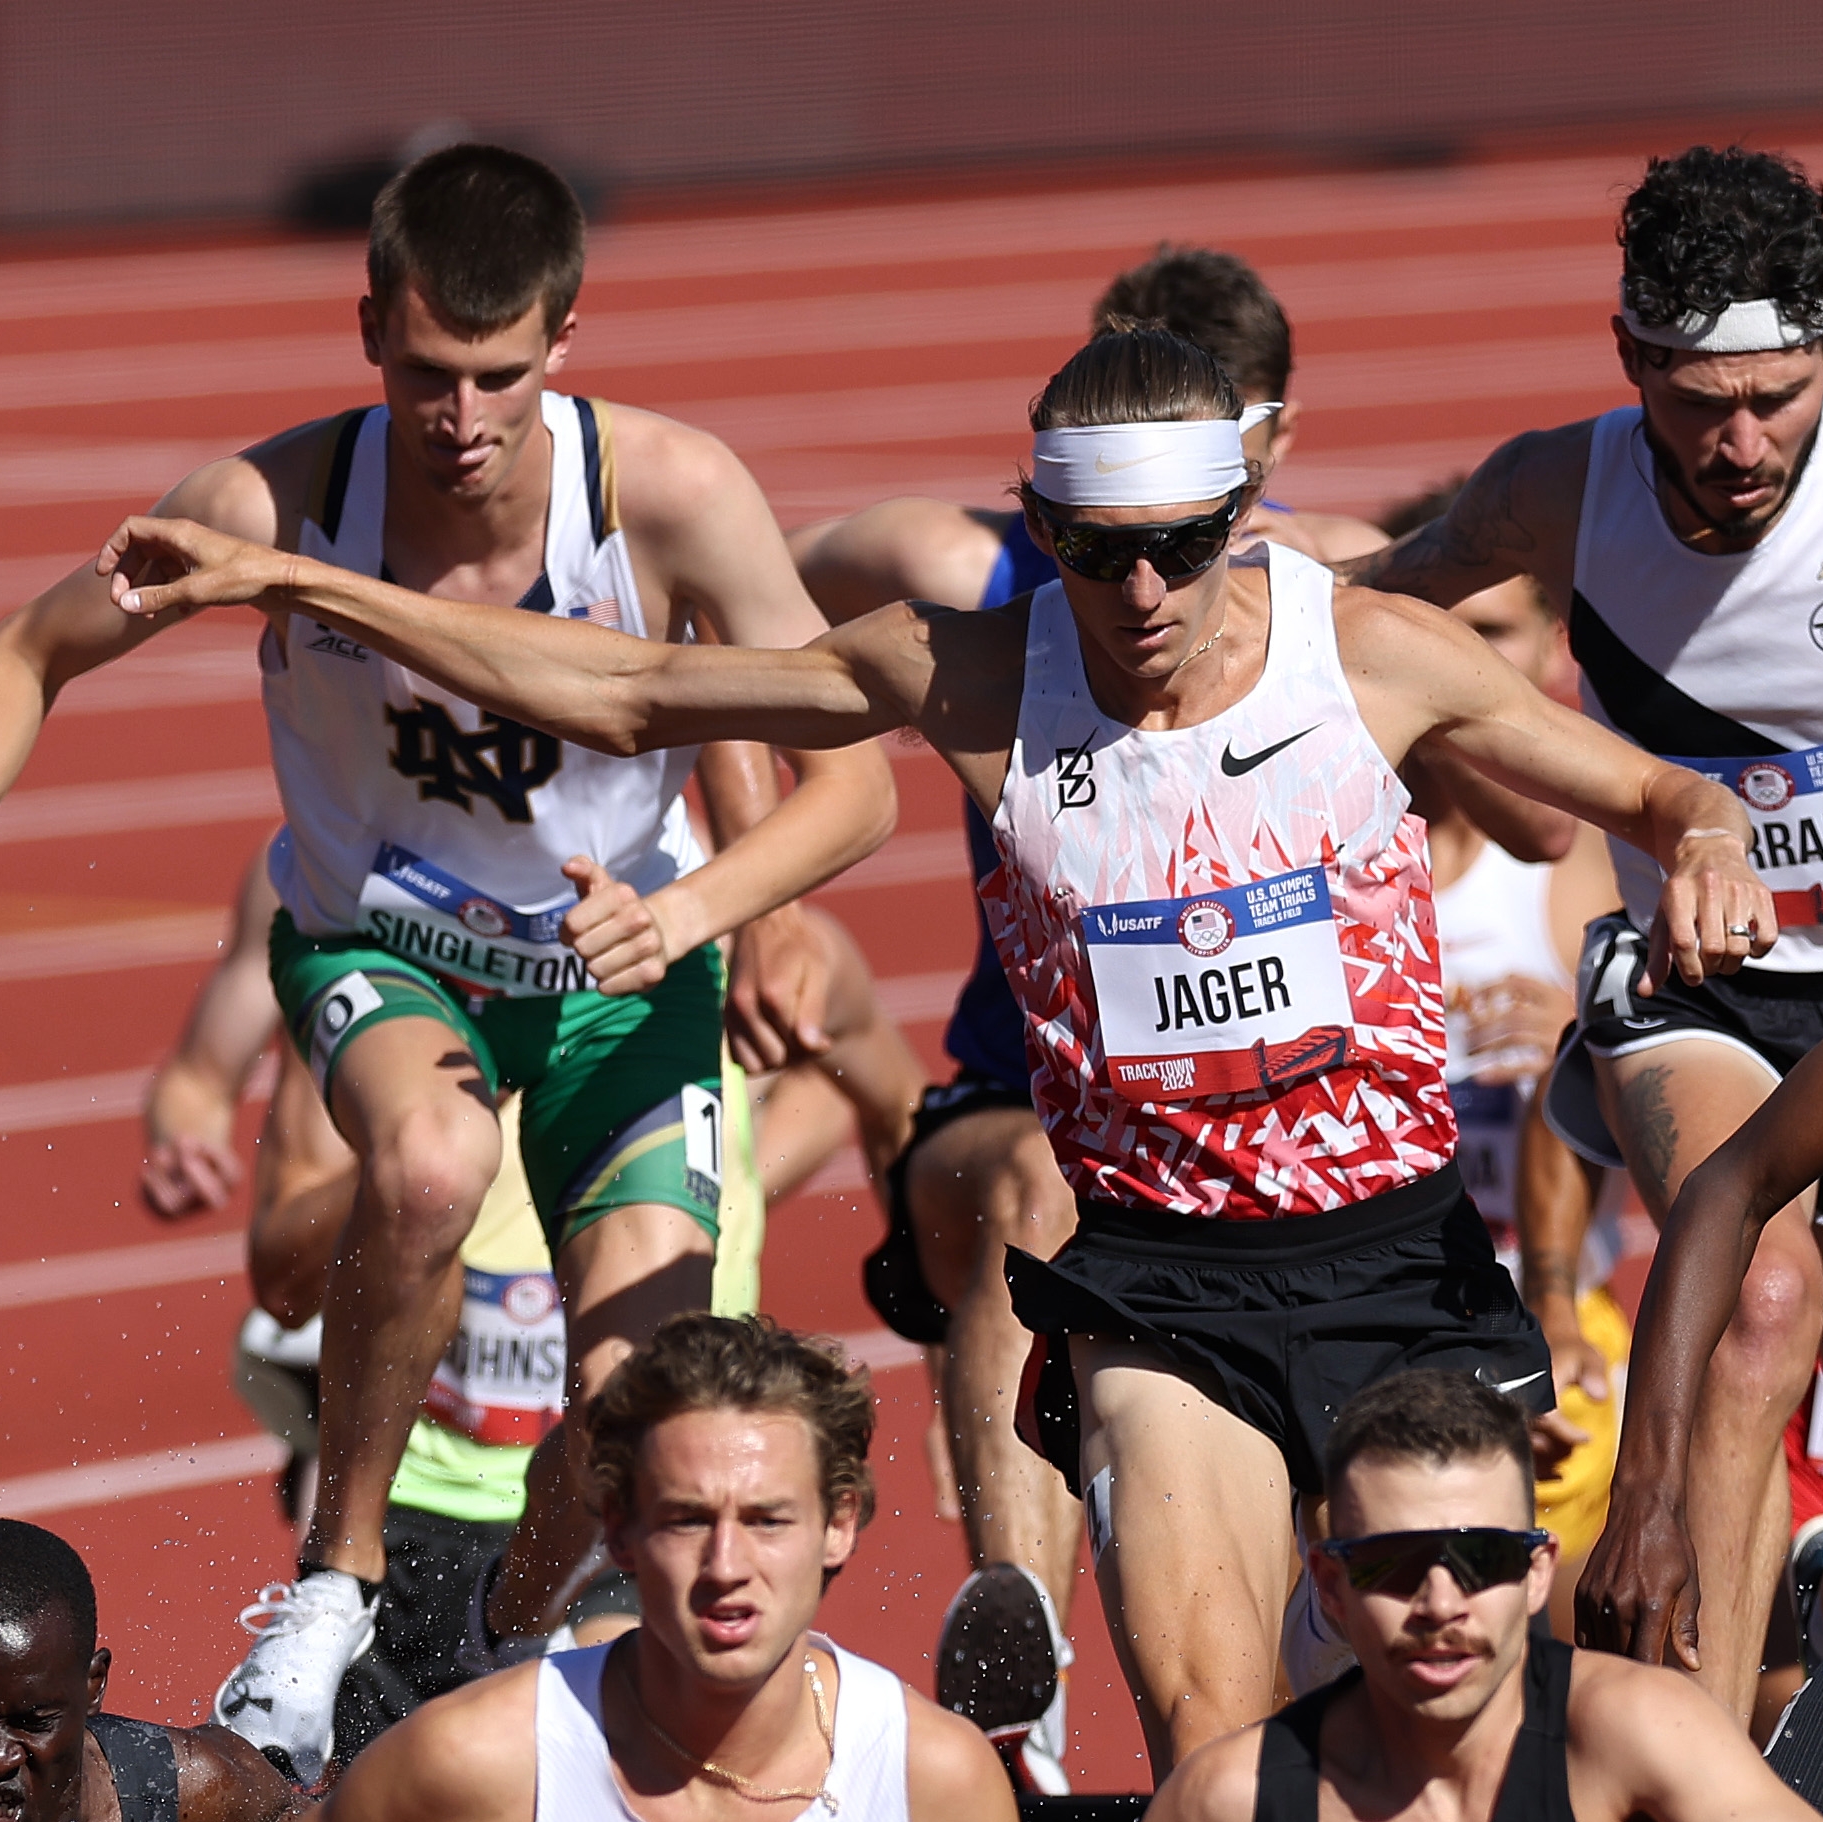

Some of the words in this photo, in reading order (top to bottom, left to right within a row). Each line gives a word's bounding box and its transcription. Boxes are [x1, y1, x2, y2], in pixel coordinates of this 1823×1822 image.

[307, 636, 370, 661] ACC
[1246, 888, 1268, 904] U.S.
[1269, 874, 1314, 896] OLYMPIC
[1249, 902, 1279, 918] TEAM
[1280, 888, 1317, 909] TRIALS
[1119, 915, 1163, 933] USATF
[1253, 914, 1276, 928] TRACK
[1283, 906, 1302, 920] FIELD
[364, 909, 589, 993] SINGLETON
[1154, 956, 1293, 1033] JAGER
[1161, 1072, 1194, 1091] 2024
